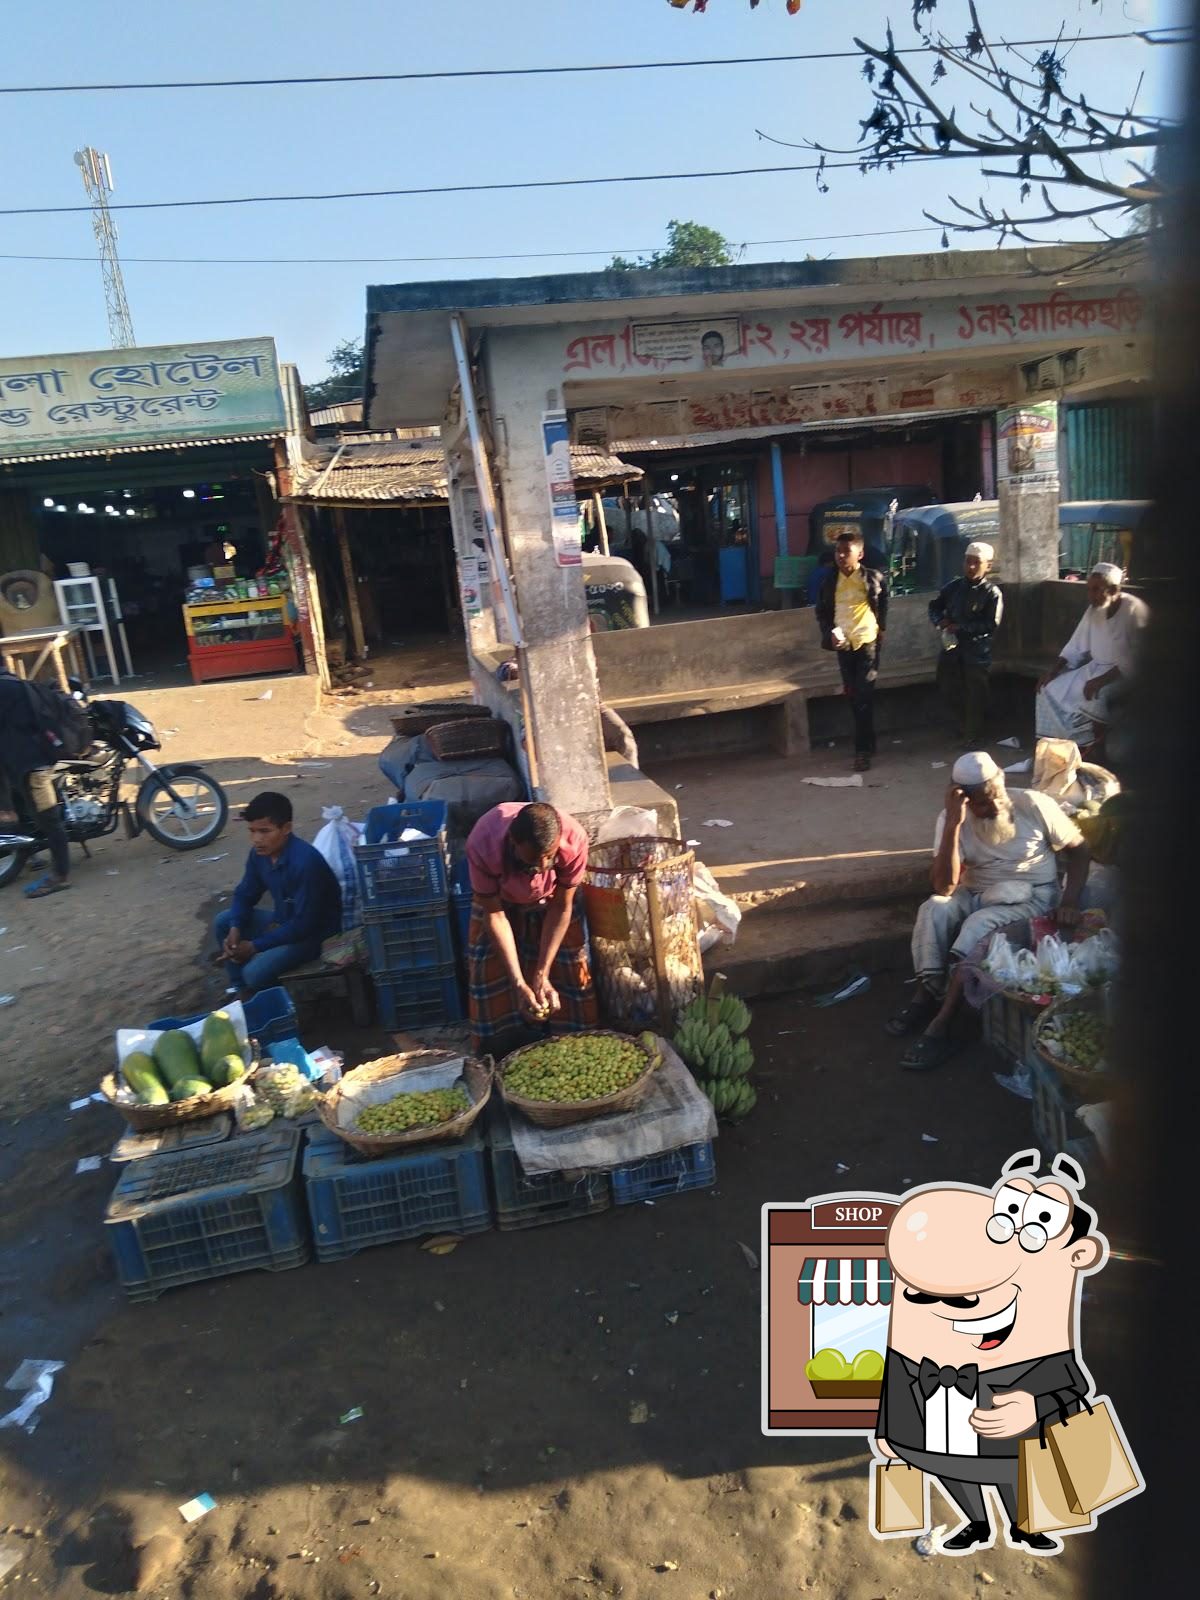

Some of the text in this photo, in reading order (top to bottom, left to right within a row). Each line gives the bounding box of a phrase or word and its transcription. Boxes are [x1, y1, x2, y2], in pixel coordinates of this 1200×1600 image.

[0, 353, 268, 399] লা হোটেল
[48, 388, 224, 423] রেস্টুরেন্ট
